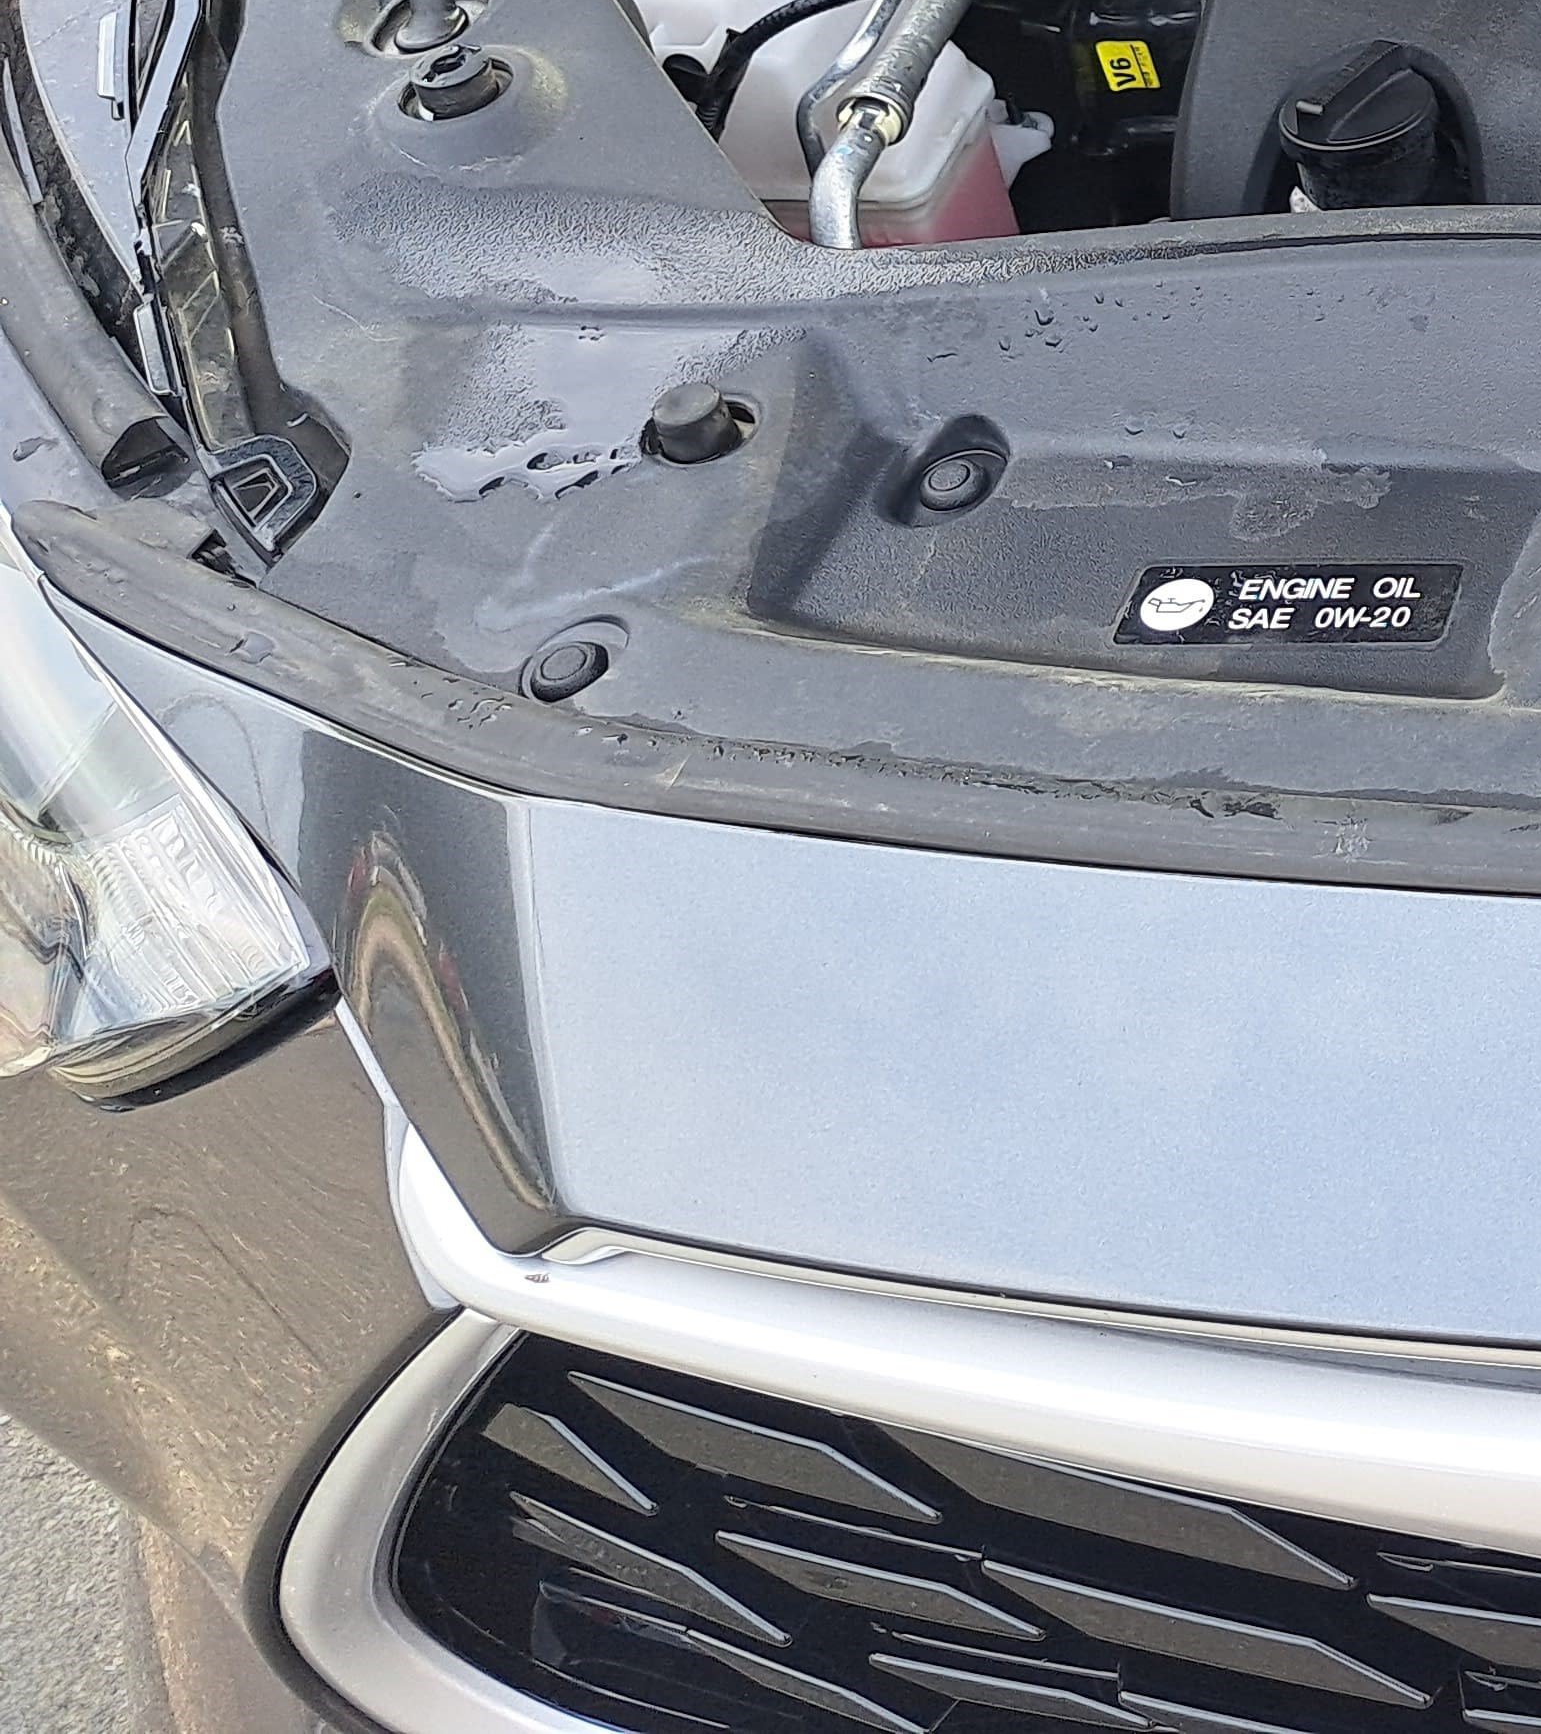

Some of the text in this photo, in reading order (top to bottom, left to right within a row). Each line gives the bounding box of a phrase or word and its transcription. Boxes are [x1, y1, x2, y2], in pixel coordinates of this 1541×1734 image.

[1109, 57, 1138, 89] V6
[1238, 576, 1422, 601] ENGINE OIL
[1227, 605, 1412, 630] SAE 0W-20
